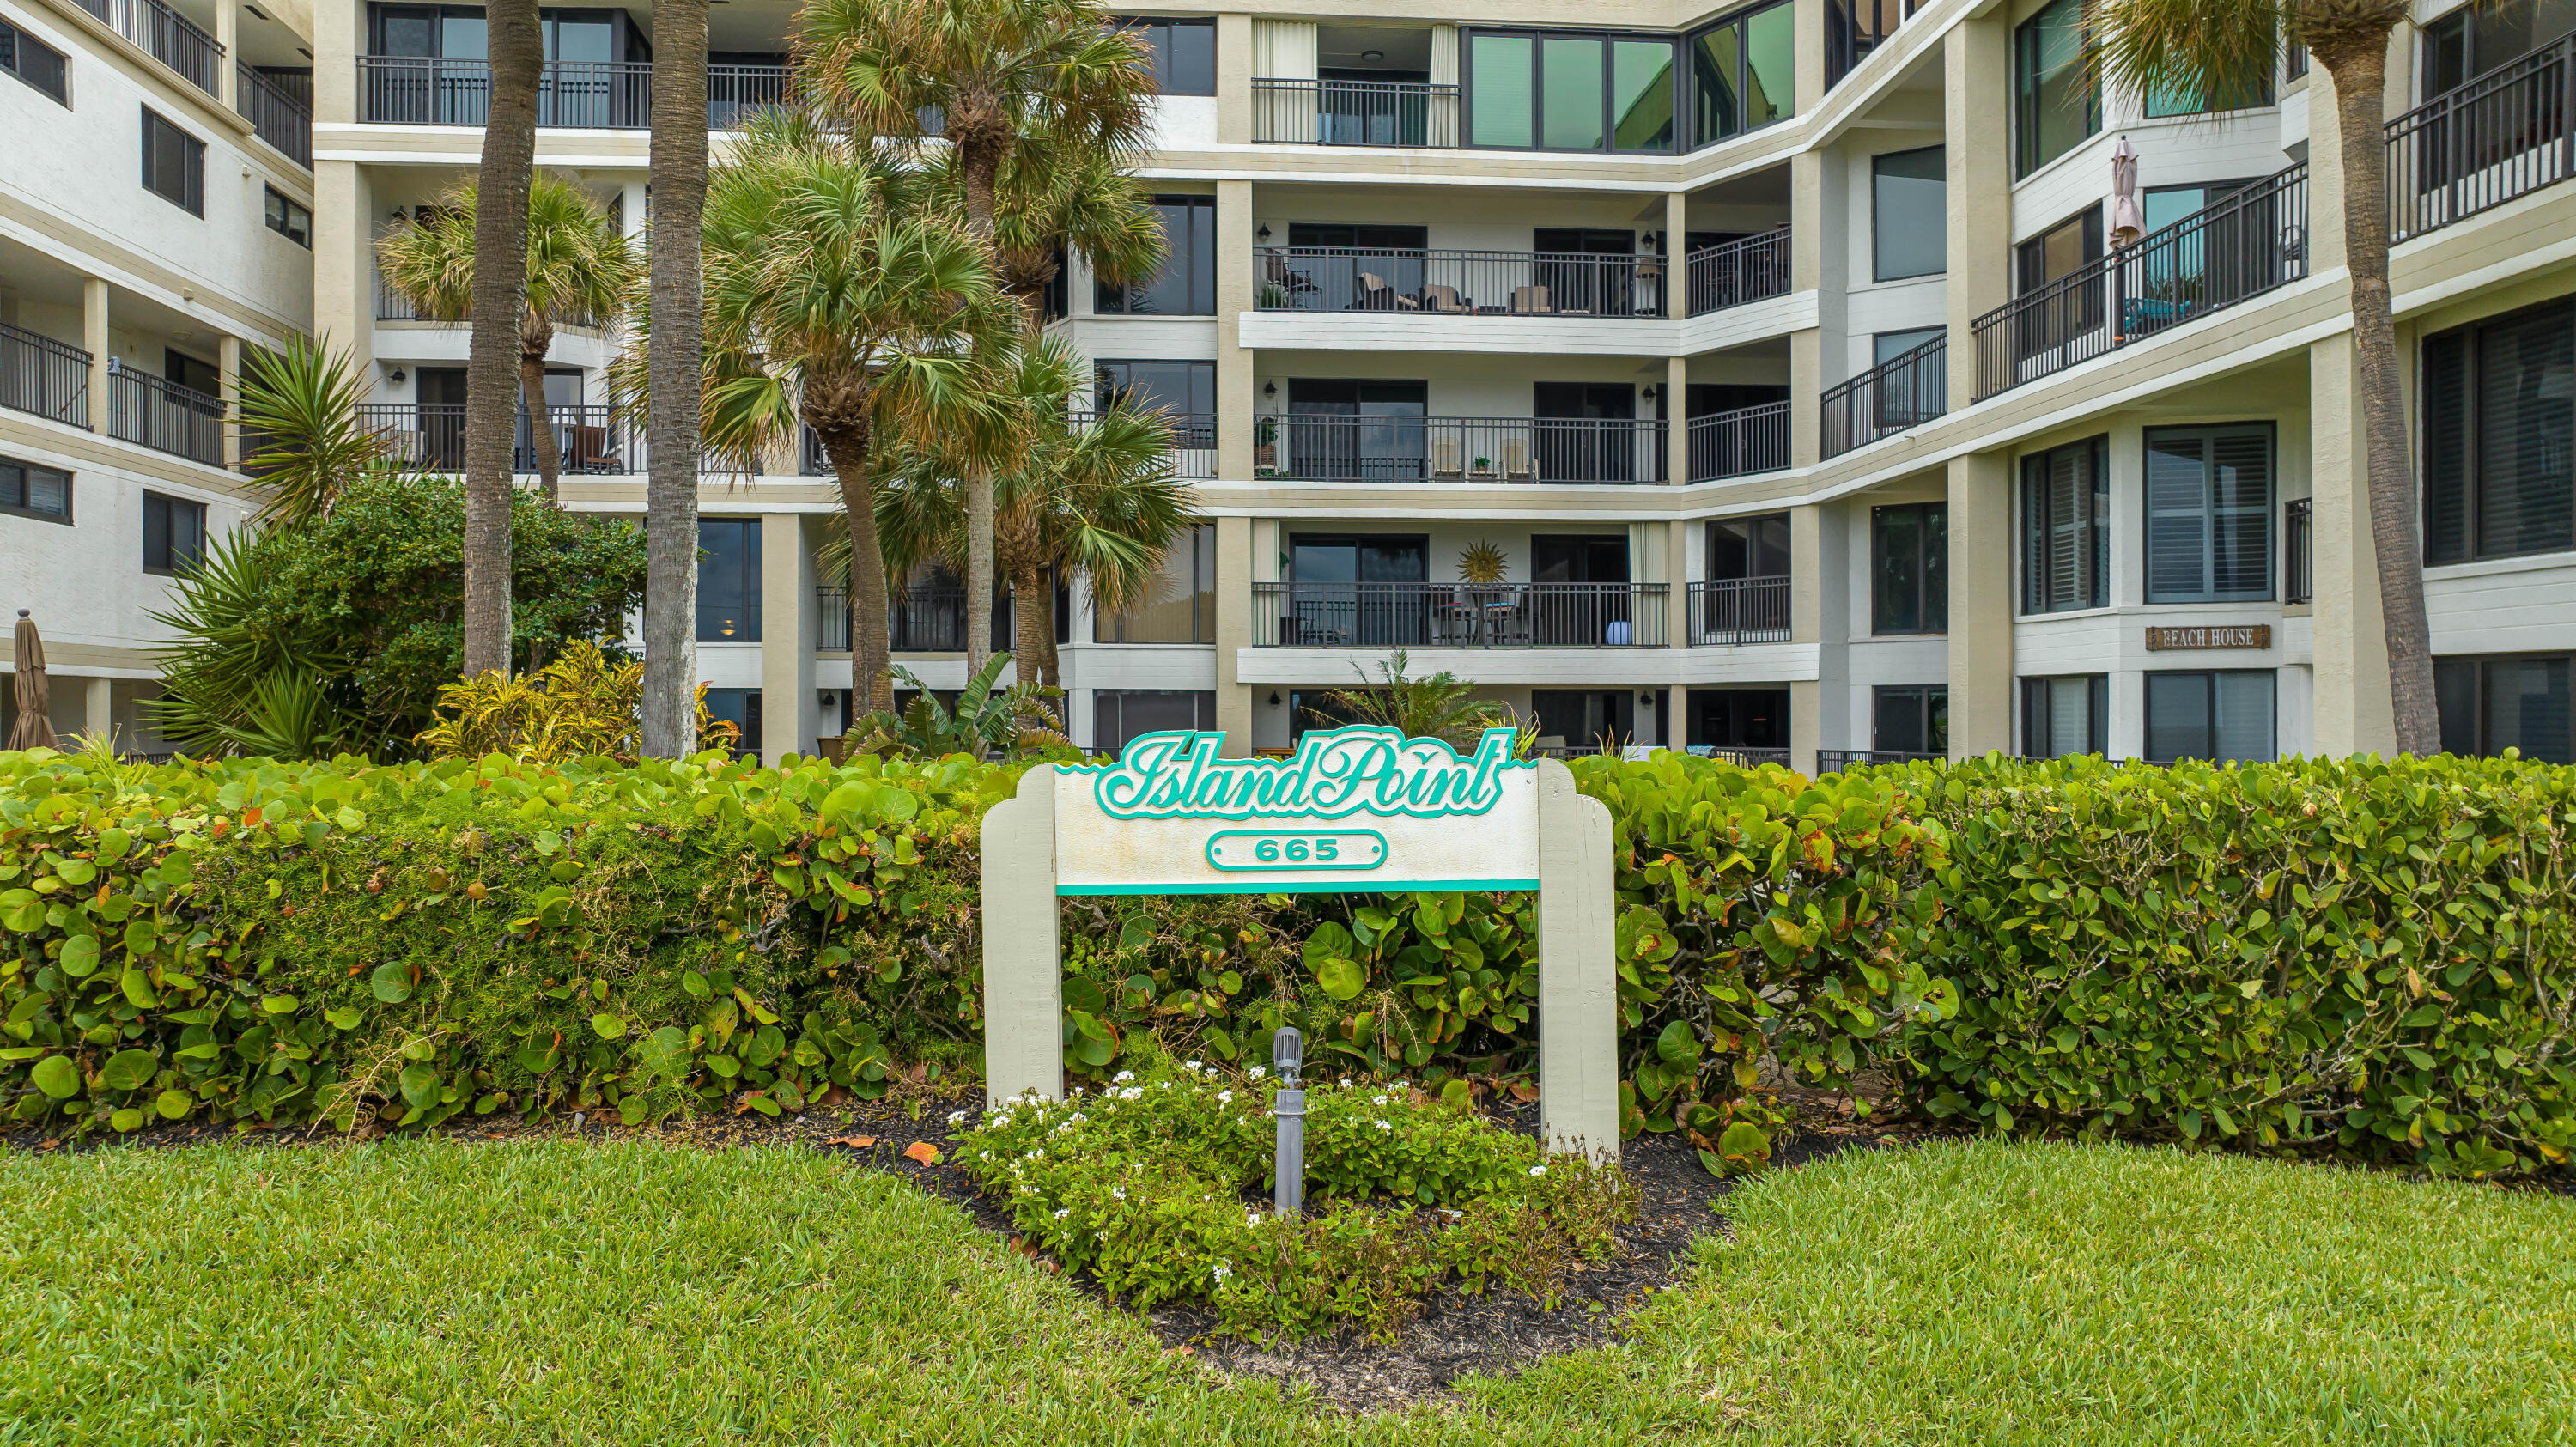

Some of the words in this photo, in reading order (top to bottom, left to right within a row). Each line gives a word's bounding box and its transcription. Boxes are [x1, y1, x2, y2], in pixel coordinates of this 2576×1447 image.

[2163, 629, 2205, 647] BEACH
[2211, 628, 2254, 646] HOUSE
[1106, 741, 1322, 808] Island
[1311, 737, 1501, 807] Point
[1255, 838, 1339, 861] 665
